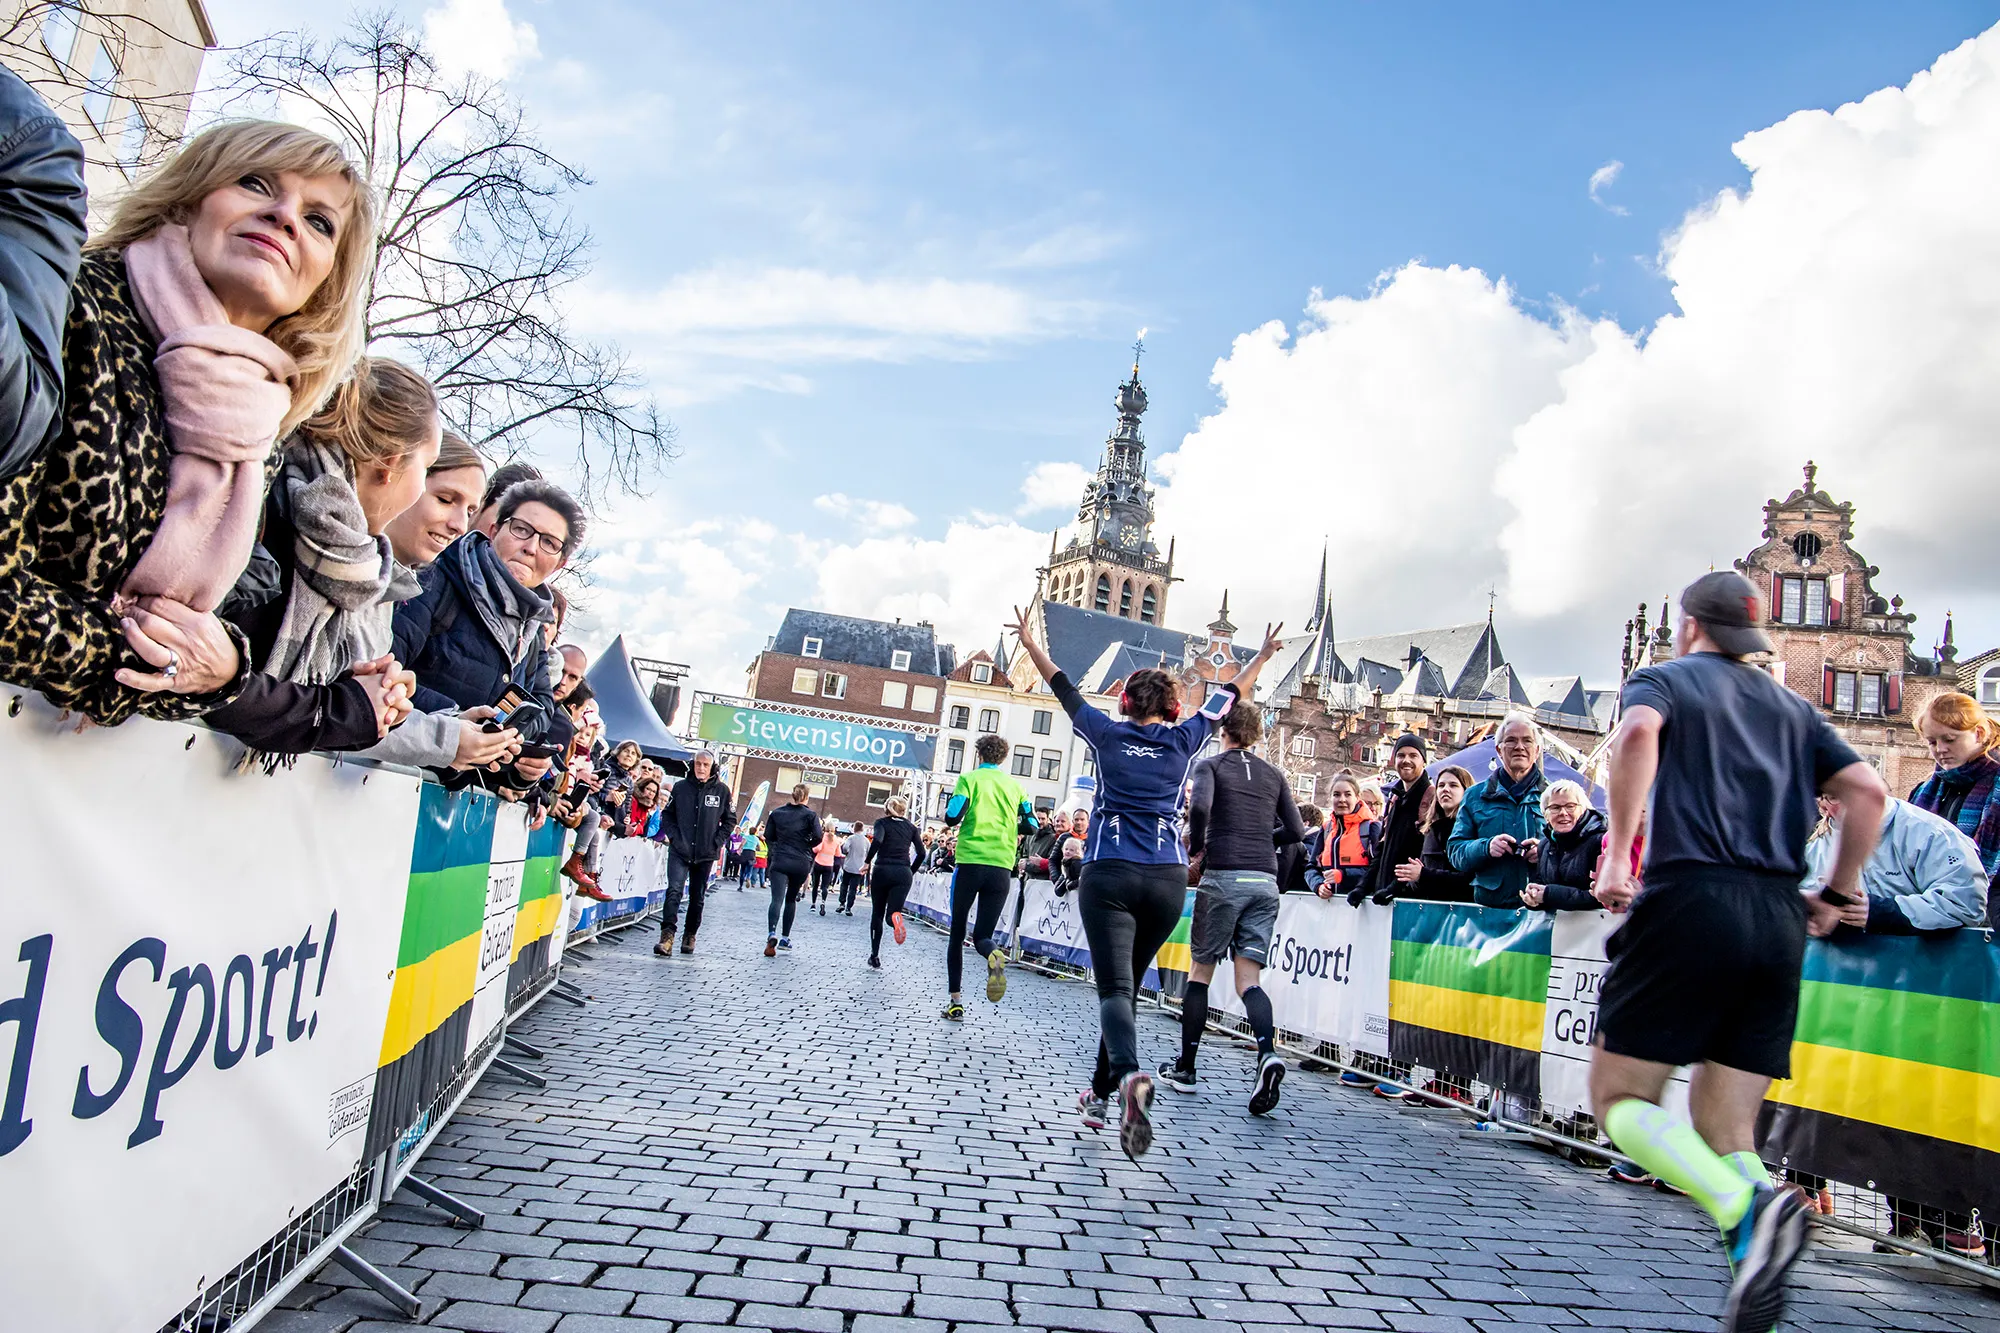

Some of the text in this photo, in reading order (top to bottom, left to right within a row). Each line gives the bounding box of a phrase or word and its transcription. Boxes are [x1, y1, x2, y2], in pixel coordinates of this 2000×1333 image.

[731, 711, 906, 764] Stevensloop
[1282, 937, 1353, 985] Sport!
[71, 908, 337, 1150] Sport!
[329, 1098, 371, 1138] Gelderland
[333, 1082, 365, 1113] provincie
